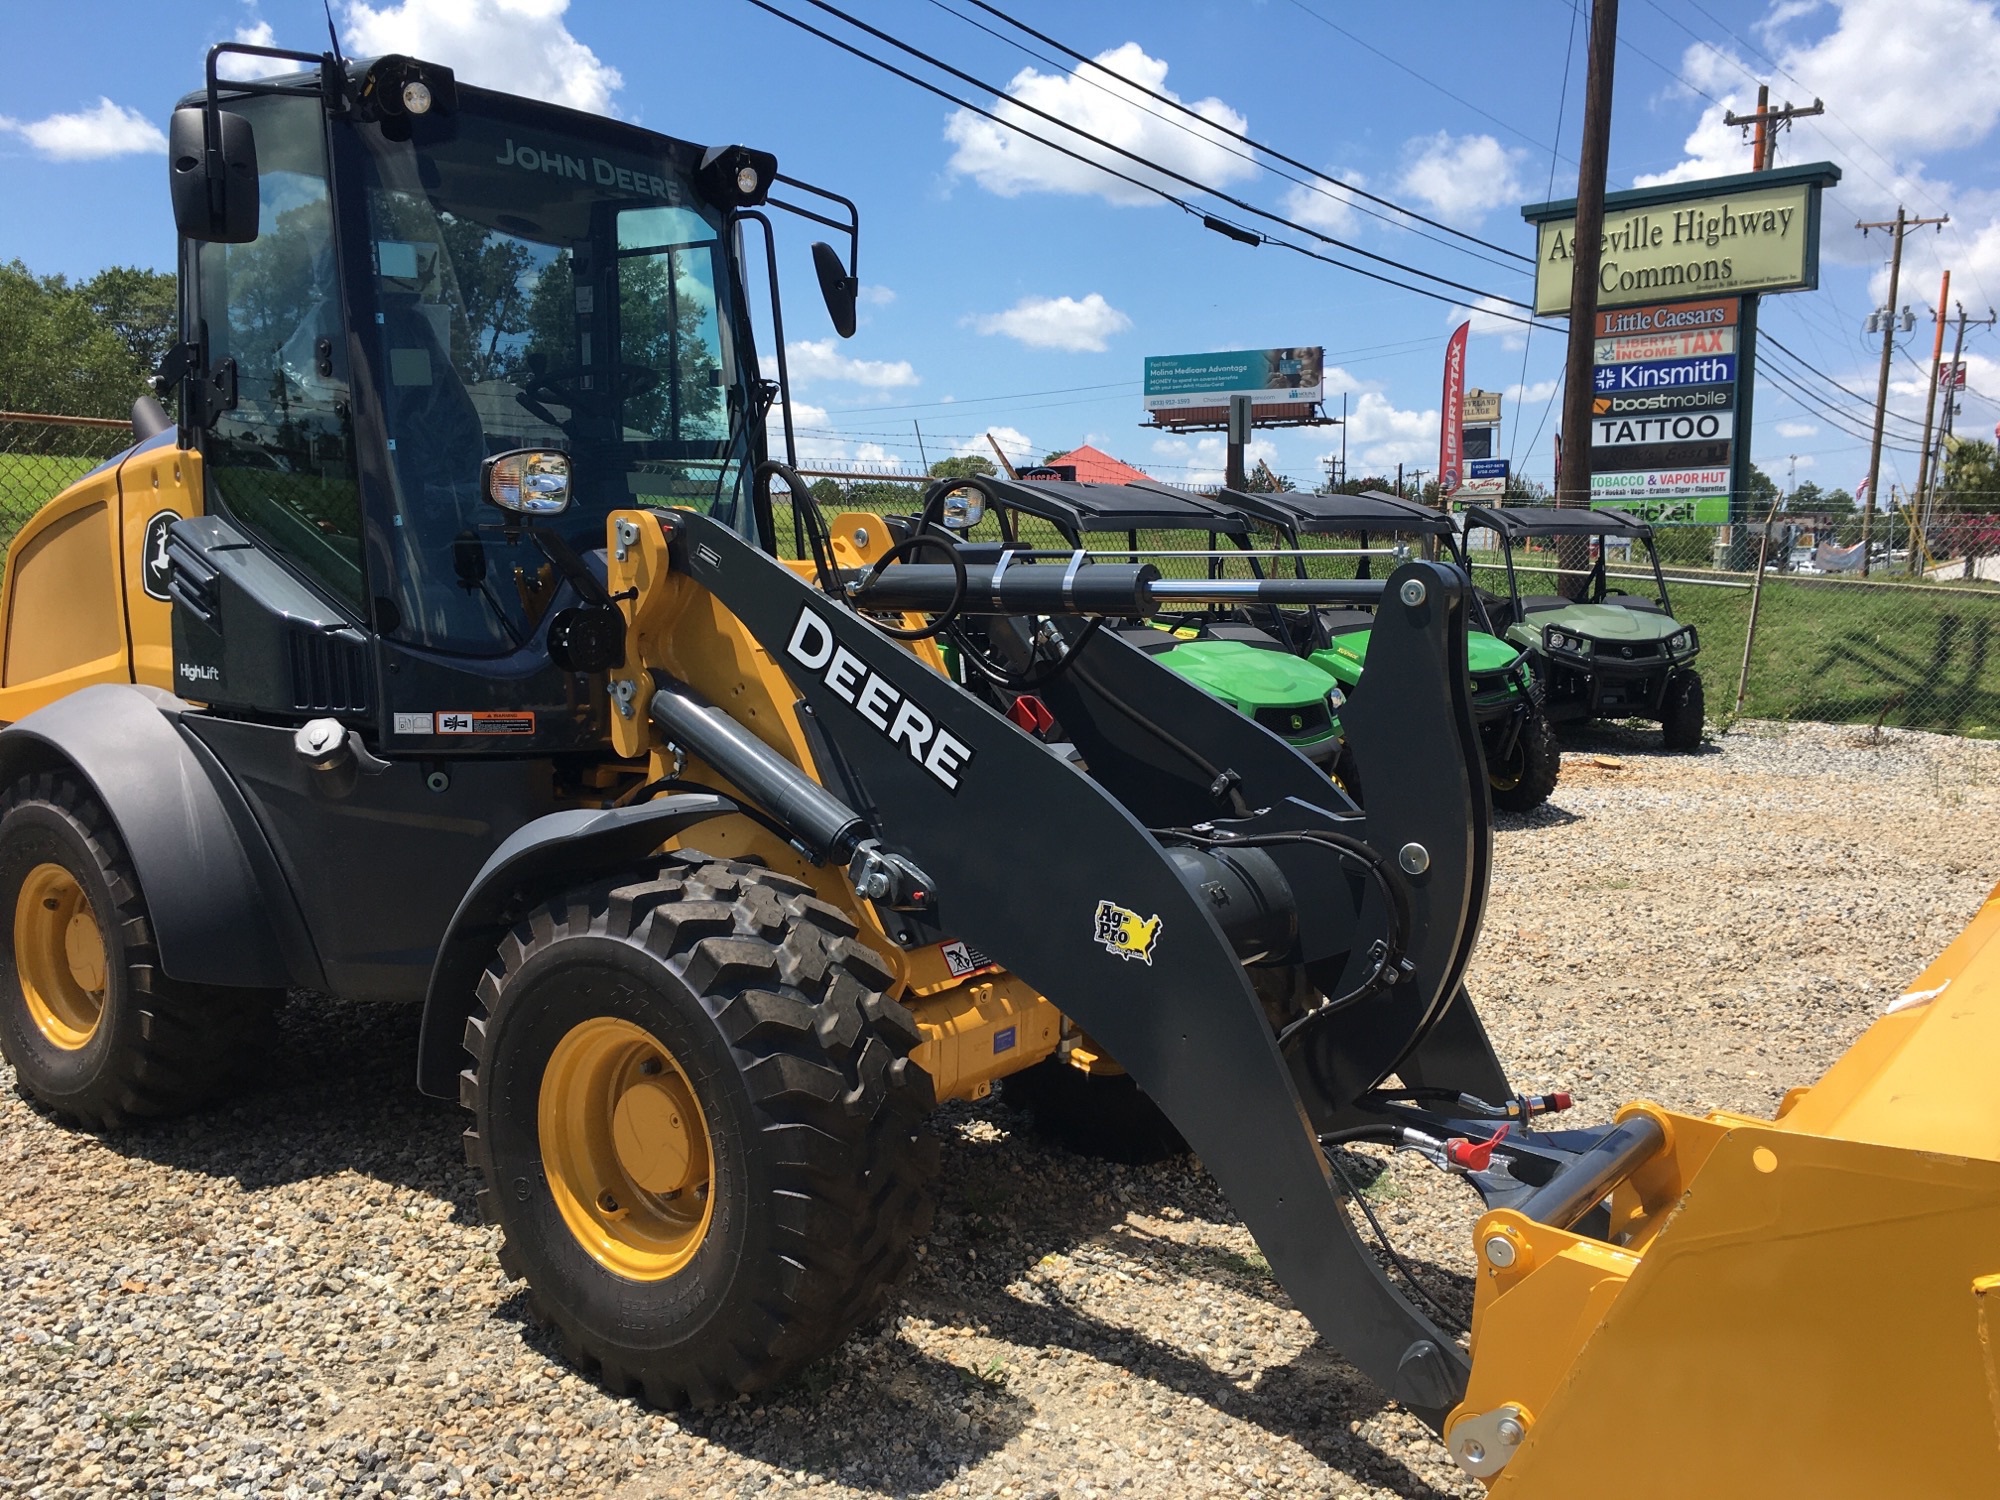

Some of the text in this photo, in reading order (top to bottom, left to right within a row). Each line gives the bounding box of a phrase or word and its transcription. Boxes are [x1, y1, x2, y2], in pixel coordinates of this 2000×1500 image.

[496, 138, 681, 201] JOHN DEERE
[1548, 204, 1794, 261] Aseville Highway
[1600, 256, 1733, 292] Commons
[1604, 308, 1724, 333] Little Caesars
[1616, 329, 1724, 354] LIBERTY TAX
[1616, 346, 1677, 361] INCOME
[1150, 365, 1247, 376] Molina Medicare Advantage
[1621, 358, 1727, 388] Kinsmith
[1464, 407, 1490, 416] ILLAGE
[1600, 414, 1719, 443] TATTOO
[1591, 472, 1726, 488] TOBACCO & VAPOR HUT
[787, 605, 971, 790] DEERE
[1099, 904, 1129, 928] Ag-
[1098, 923, 1128, 943] Pro
